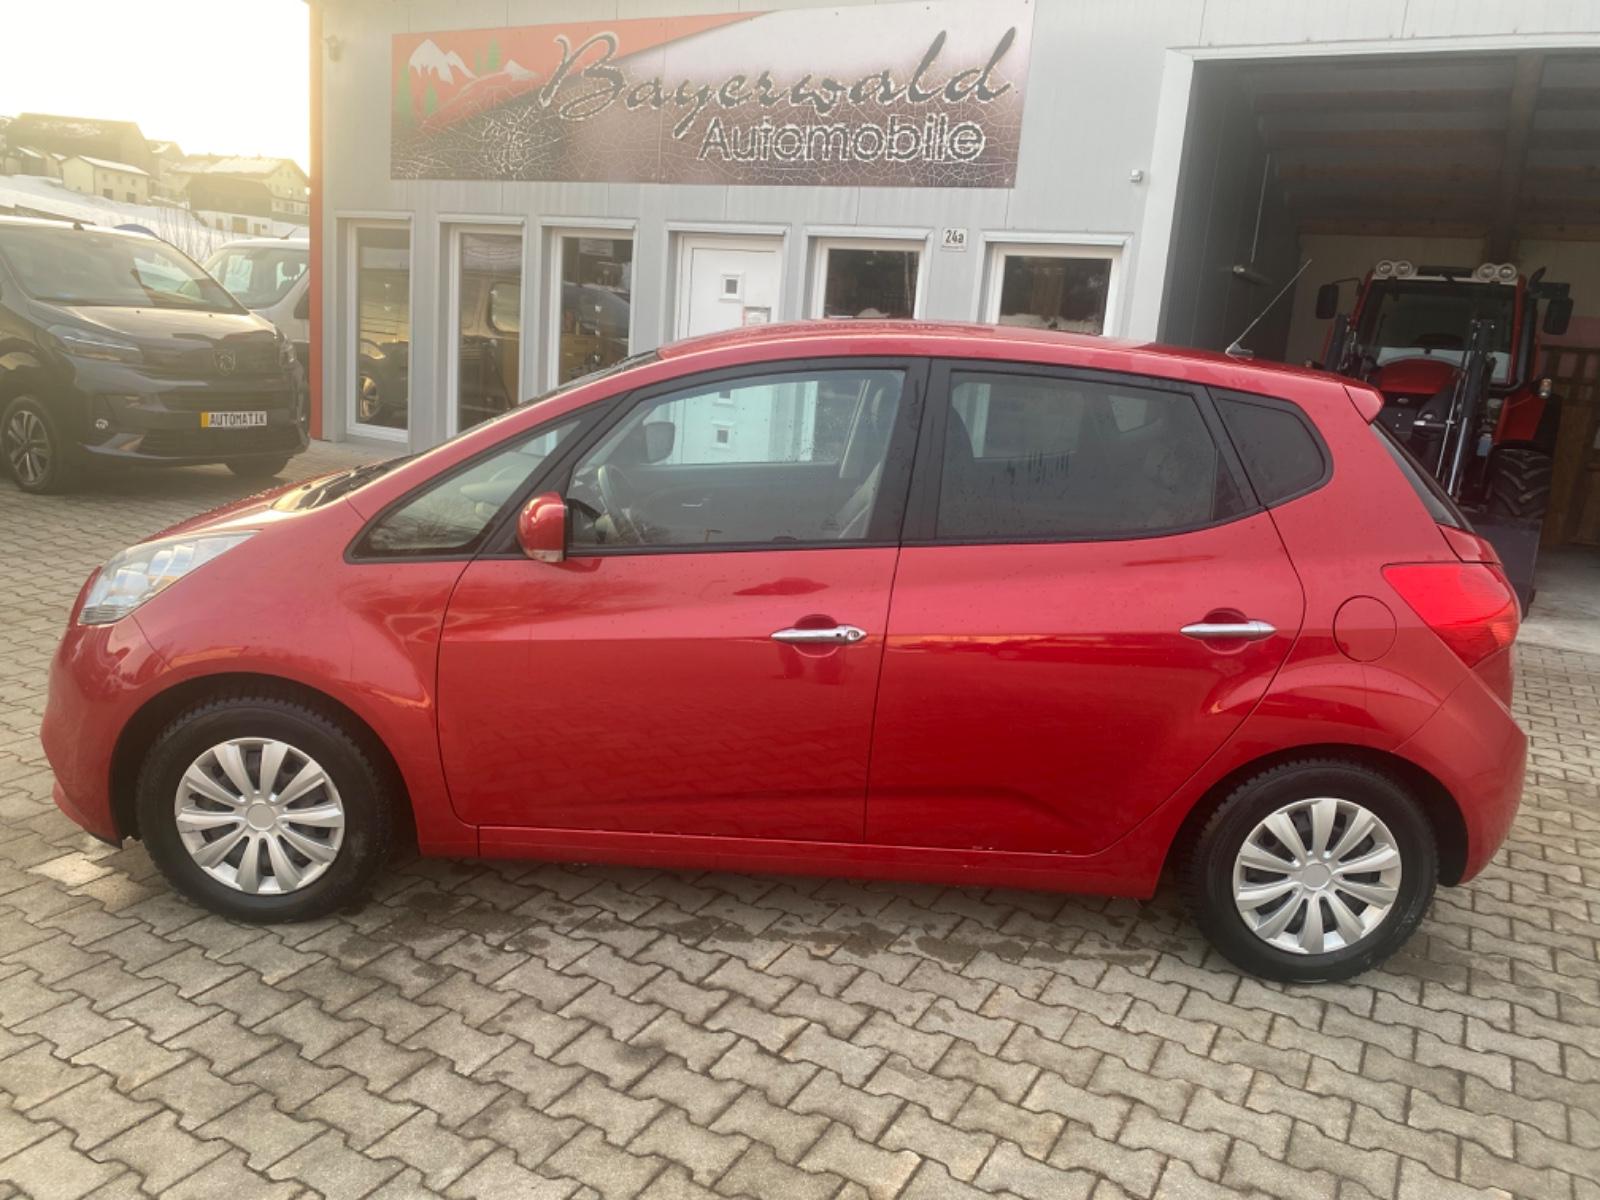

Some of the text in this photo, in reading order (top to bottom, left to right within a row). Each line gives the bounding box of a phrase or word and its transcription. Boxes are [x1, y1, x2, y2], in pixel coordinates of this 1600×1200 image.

[538, 27, 1016, 139] Bayerwald
[698, 114, 986, 163] Automobile
[209, 413, 267, 427] AUTOMATIK
